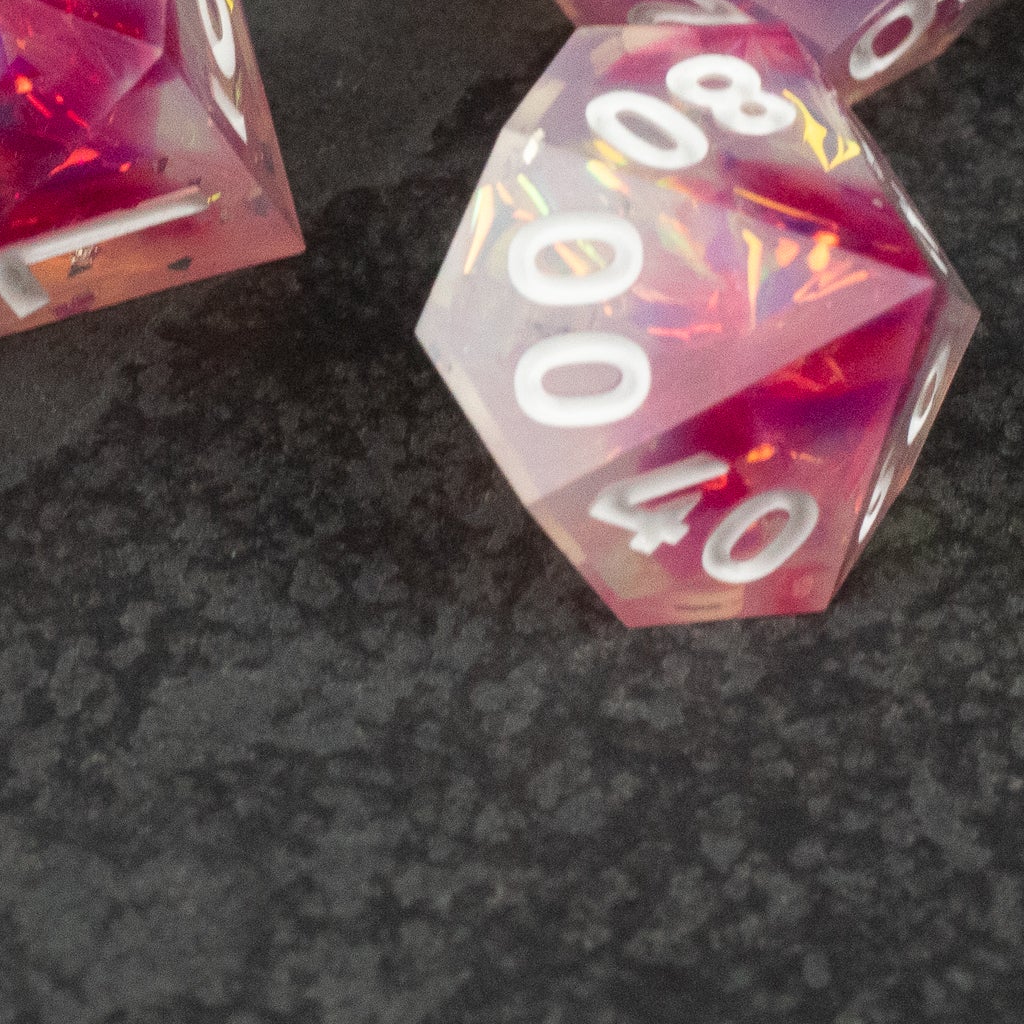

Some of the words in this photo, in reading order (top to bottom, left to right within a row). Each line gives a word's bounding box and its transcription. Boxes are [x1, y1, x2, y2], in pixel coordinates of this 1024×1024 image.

[585, 54, 796, 169] 80
[508, 212, 650, 428] 00
[589, 451, 818, 583] 40
